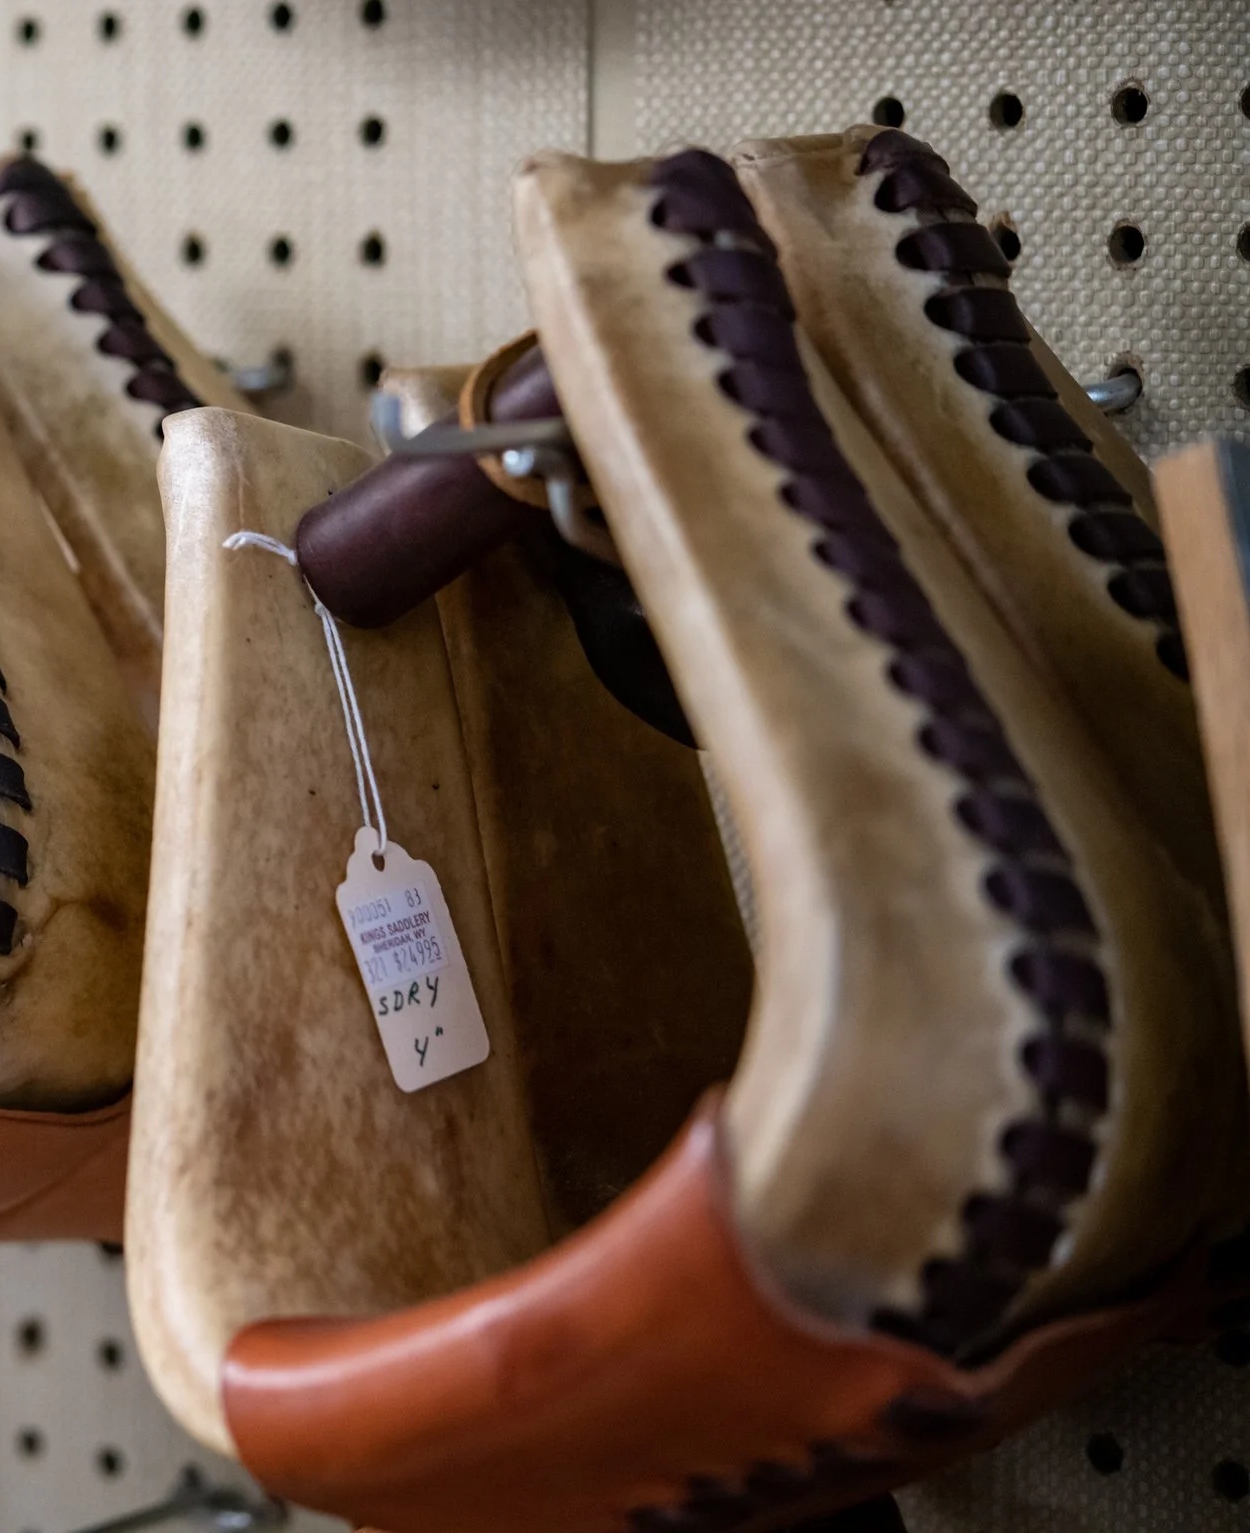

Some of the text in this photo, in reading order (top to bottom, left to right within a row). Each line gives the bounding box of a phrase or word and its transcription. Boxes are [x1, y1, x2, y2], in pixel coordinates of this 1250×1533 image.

[404, 887, 422, 908] 83
[359, 910, 432, 945] KINGS SADDLERY
[415, 927, 427, 941] WY
